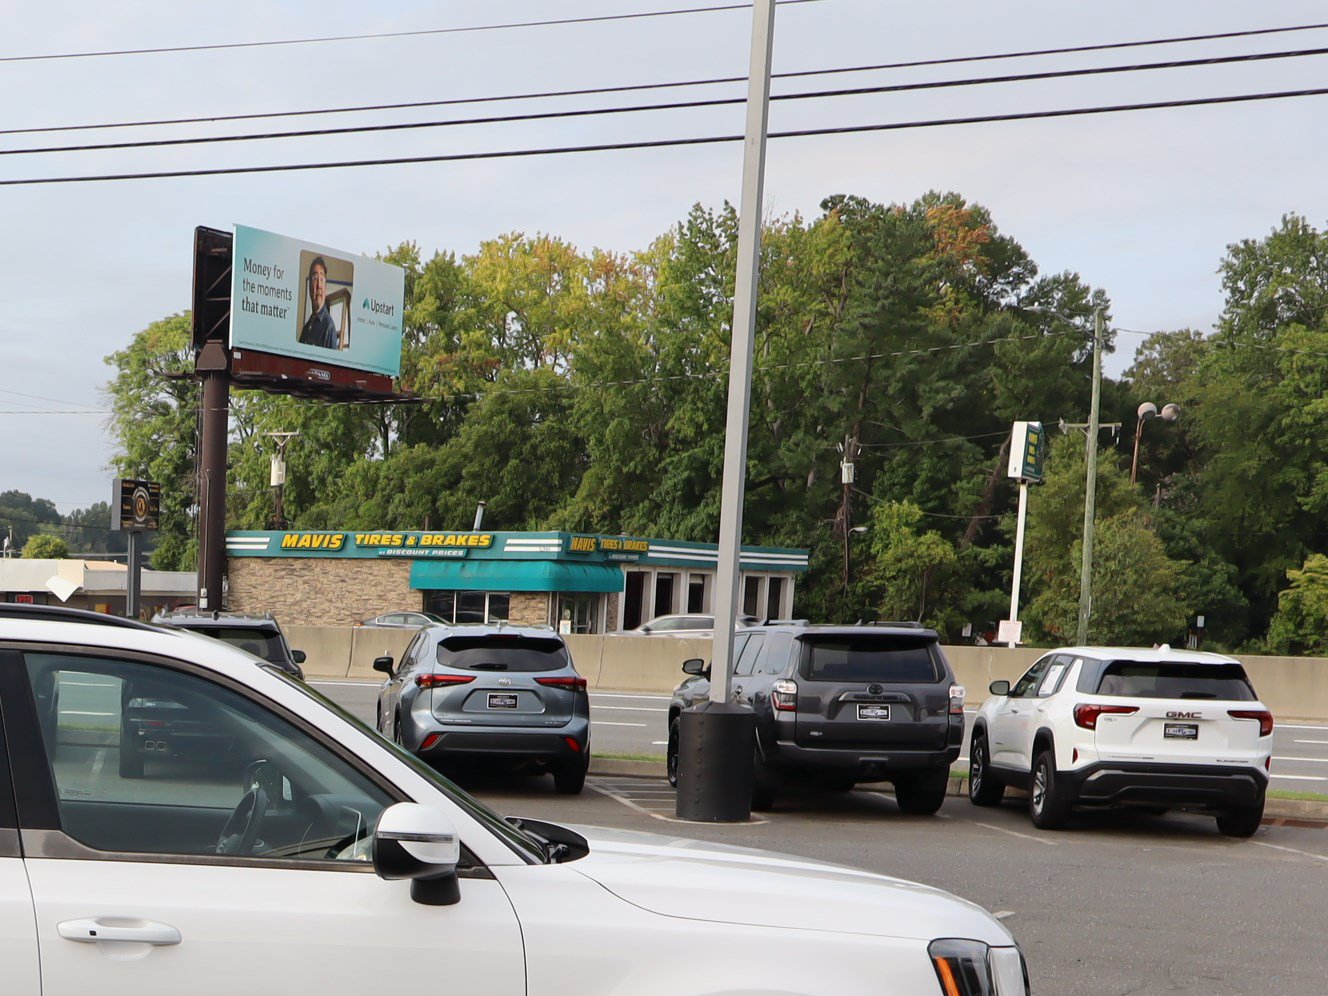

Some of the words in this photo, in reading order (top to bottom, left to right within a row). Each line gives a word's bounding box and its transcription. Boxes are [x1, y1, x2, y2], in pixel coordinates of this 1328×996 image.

[243, 257, 272, 280] Money
[273, 264, 284, 280] for
[242, 278, 255, 294] the
[257, 283, 292, 301] moments
[241, 296, 259, 314] that
[370, 298, 394, 317] Upstart
[281, 534, 345, 549] MAVIS
[355, 534, 403, 546] TIRES
[406, 536, 417, 546] &
[419, 535, 492, 547] BRAKES
[570, 537, 597, 552] MAVIS
[600, 538, 619, 550] TIRES
[623, 541, 649, 552] BRAKES
[1165, 711, 1203, 719] GMC
